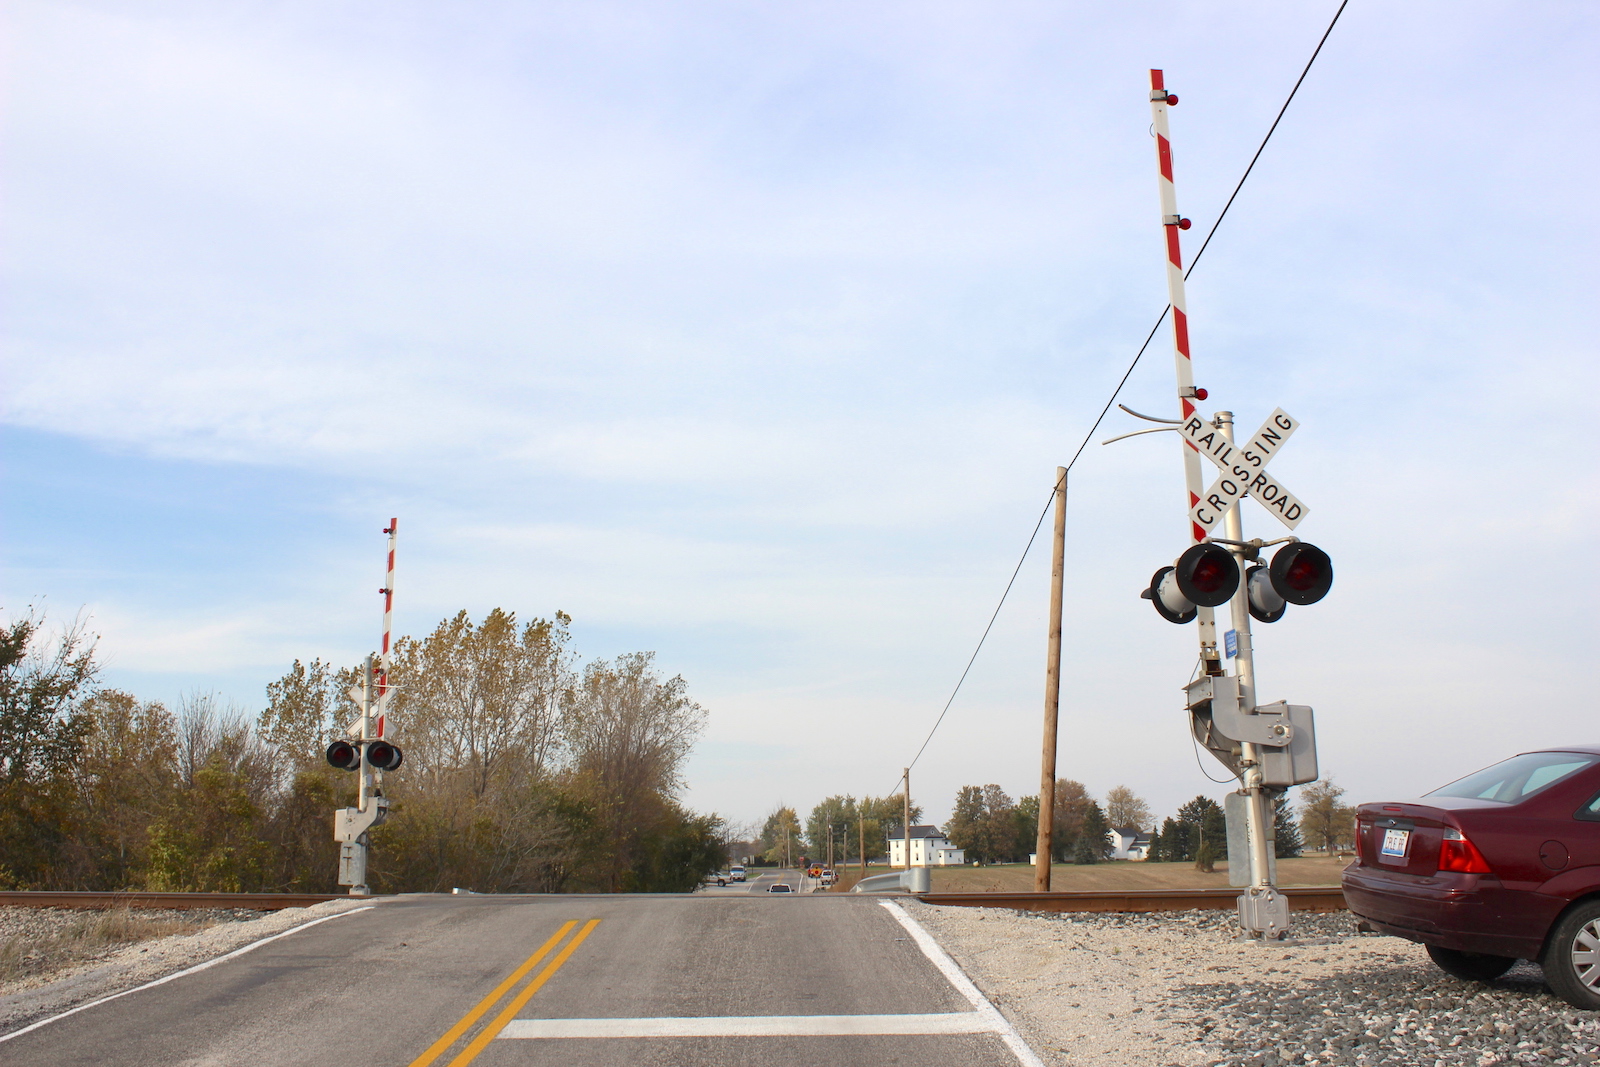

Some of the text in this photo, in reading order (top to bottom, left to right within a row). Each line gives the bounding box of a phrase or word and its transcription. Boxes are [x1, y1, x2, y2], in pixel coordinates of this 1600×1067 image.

[1184, 417, 1302, 521] RAIL ROAD
[1197, 414, 1292, 525] CROSSING
